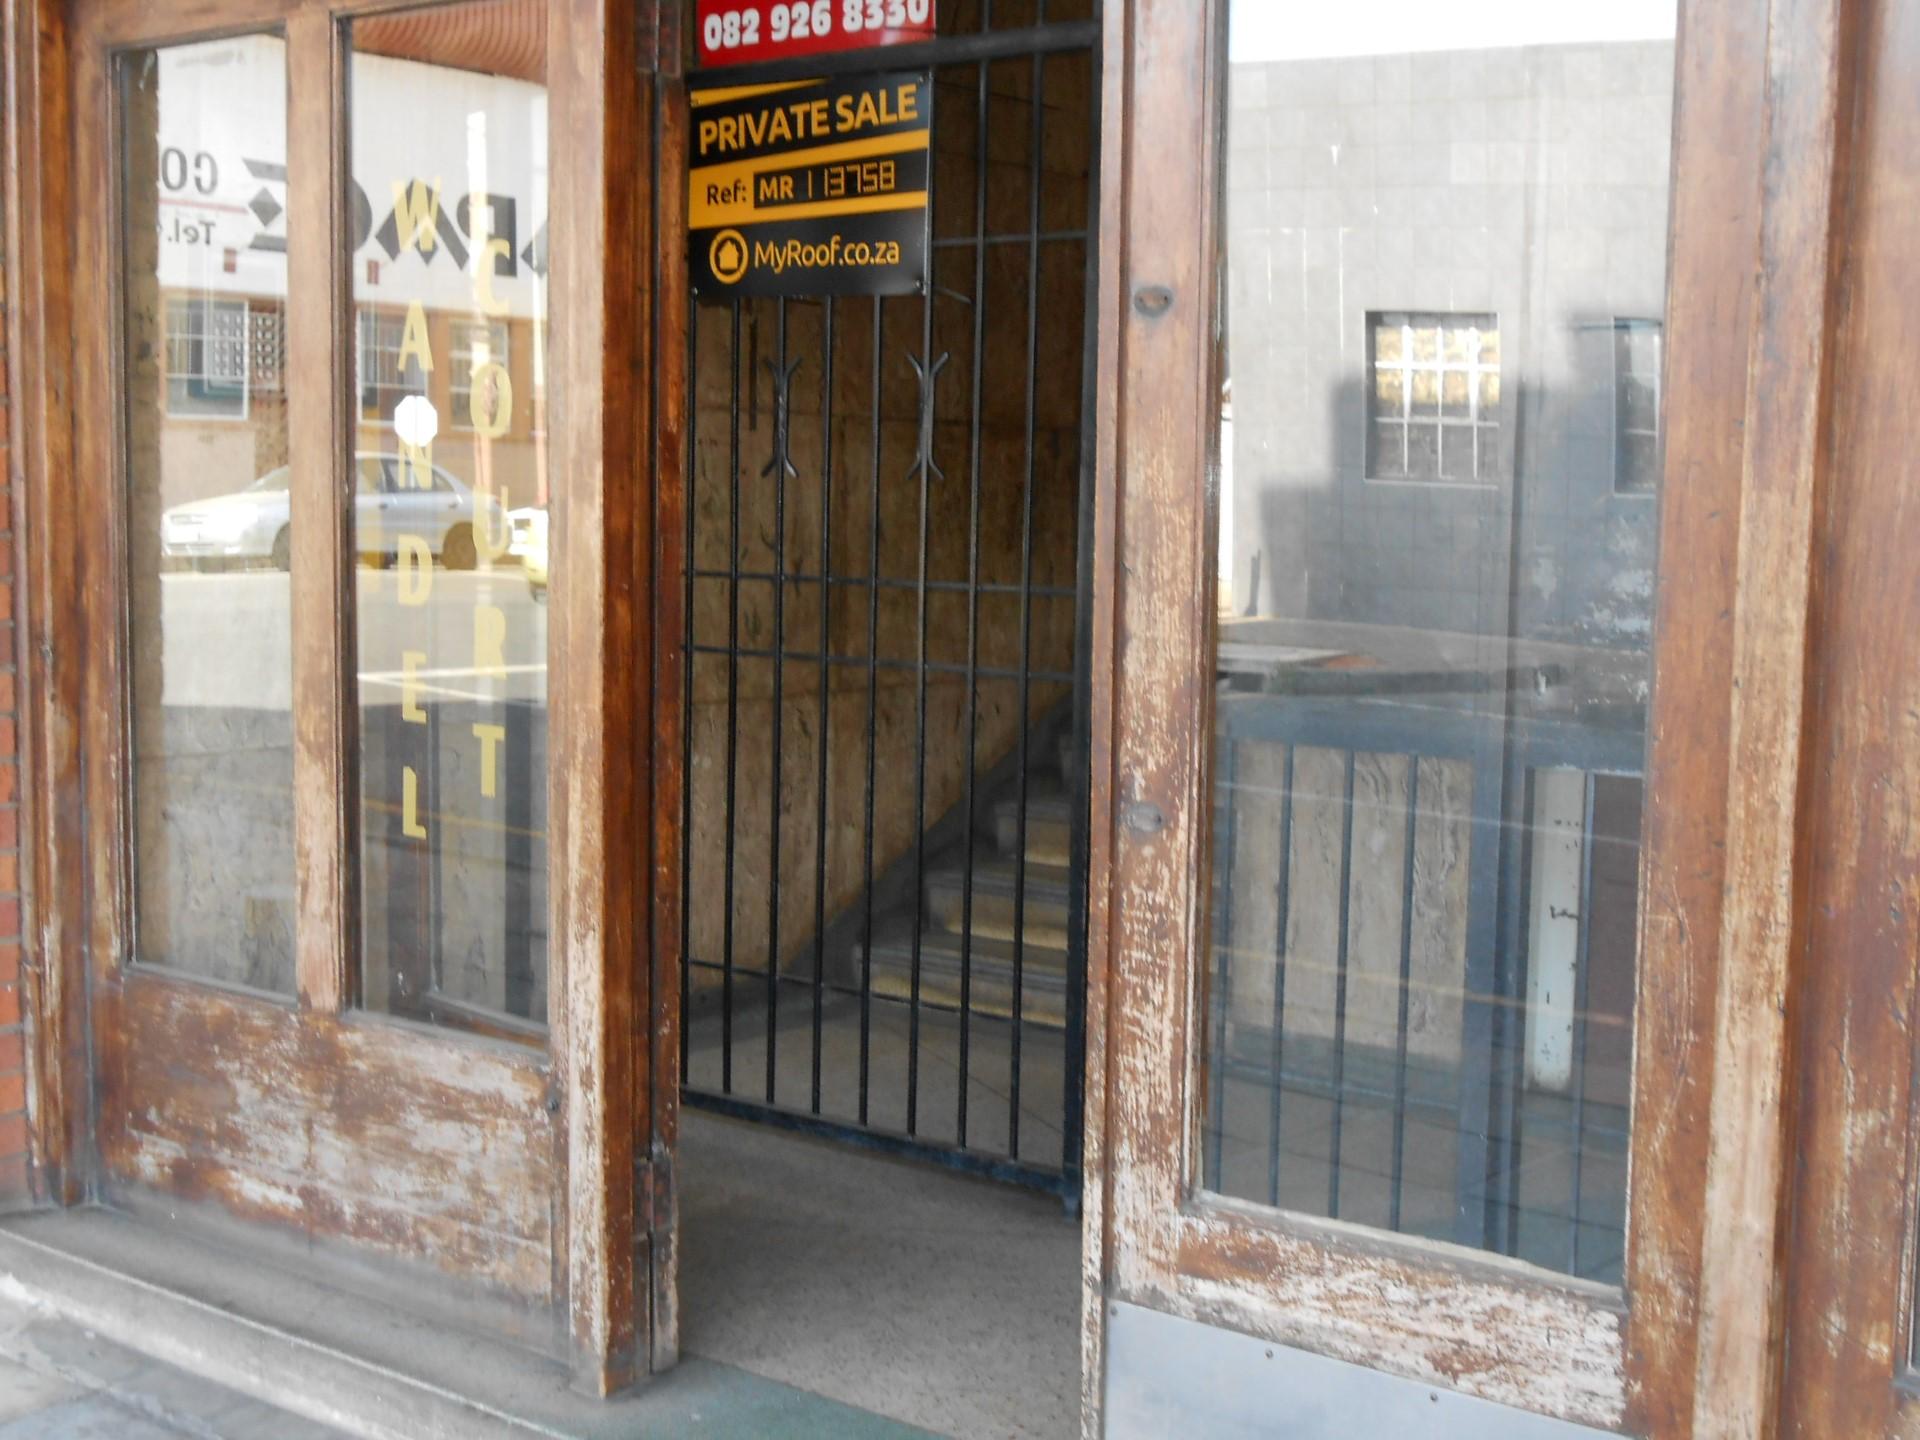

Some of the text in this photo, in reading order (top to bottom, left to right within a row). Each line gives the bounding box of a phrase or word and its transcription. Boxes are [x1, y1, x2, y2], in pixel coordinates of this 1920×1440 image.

[704, 0, 930, 51] 082 926 8330
[700, 83, 918, 155] PRIVATE SALE
[706, 178, 747, 206] Ref:
[759, 175, 794, 202] MR
[754, 235, 900, 274] MyRoof.co.za
[470, 238, 513, 797] COURT
